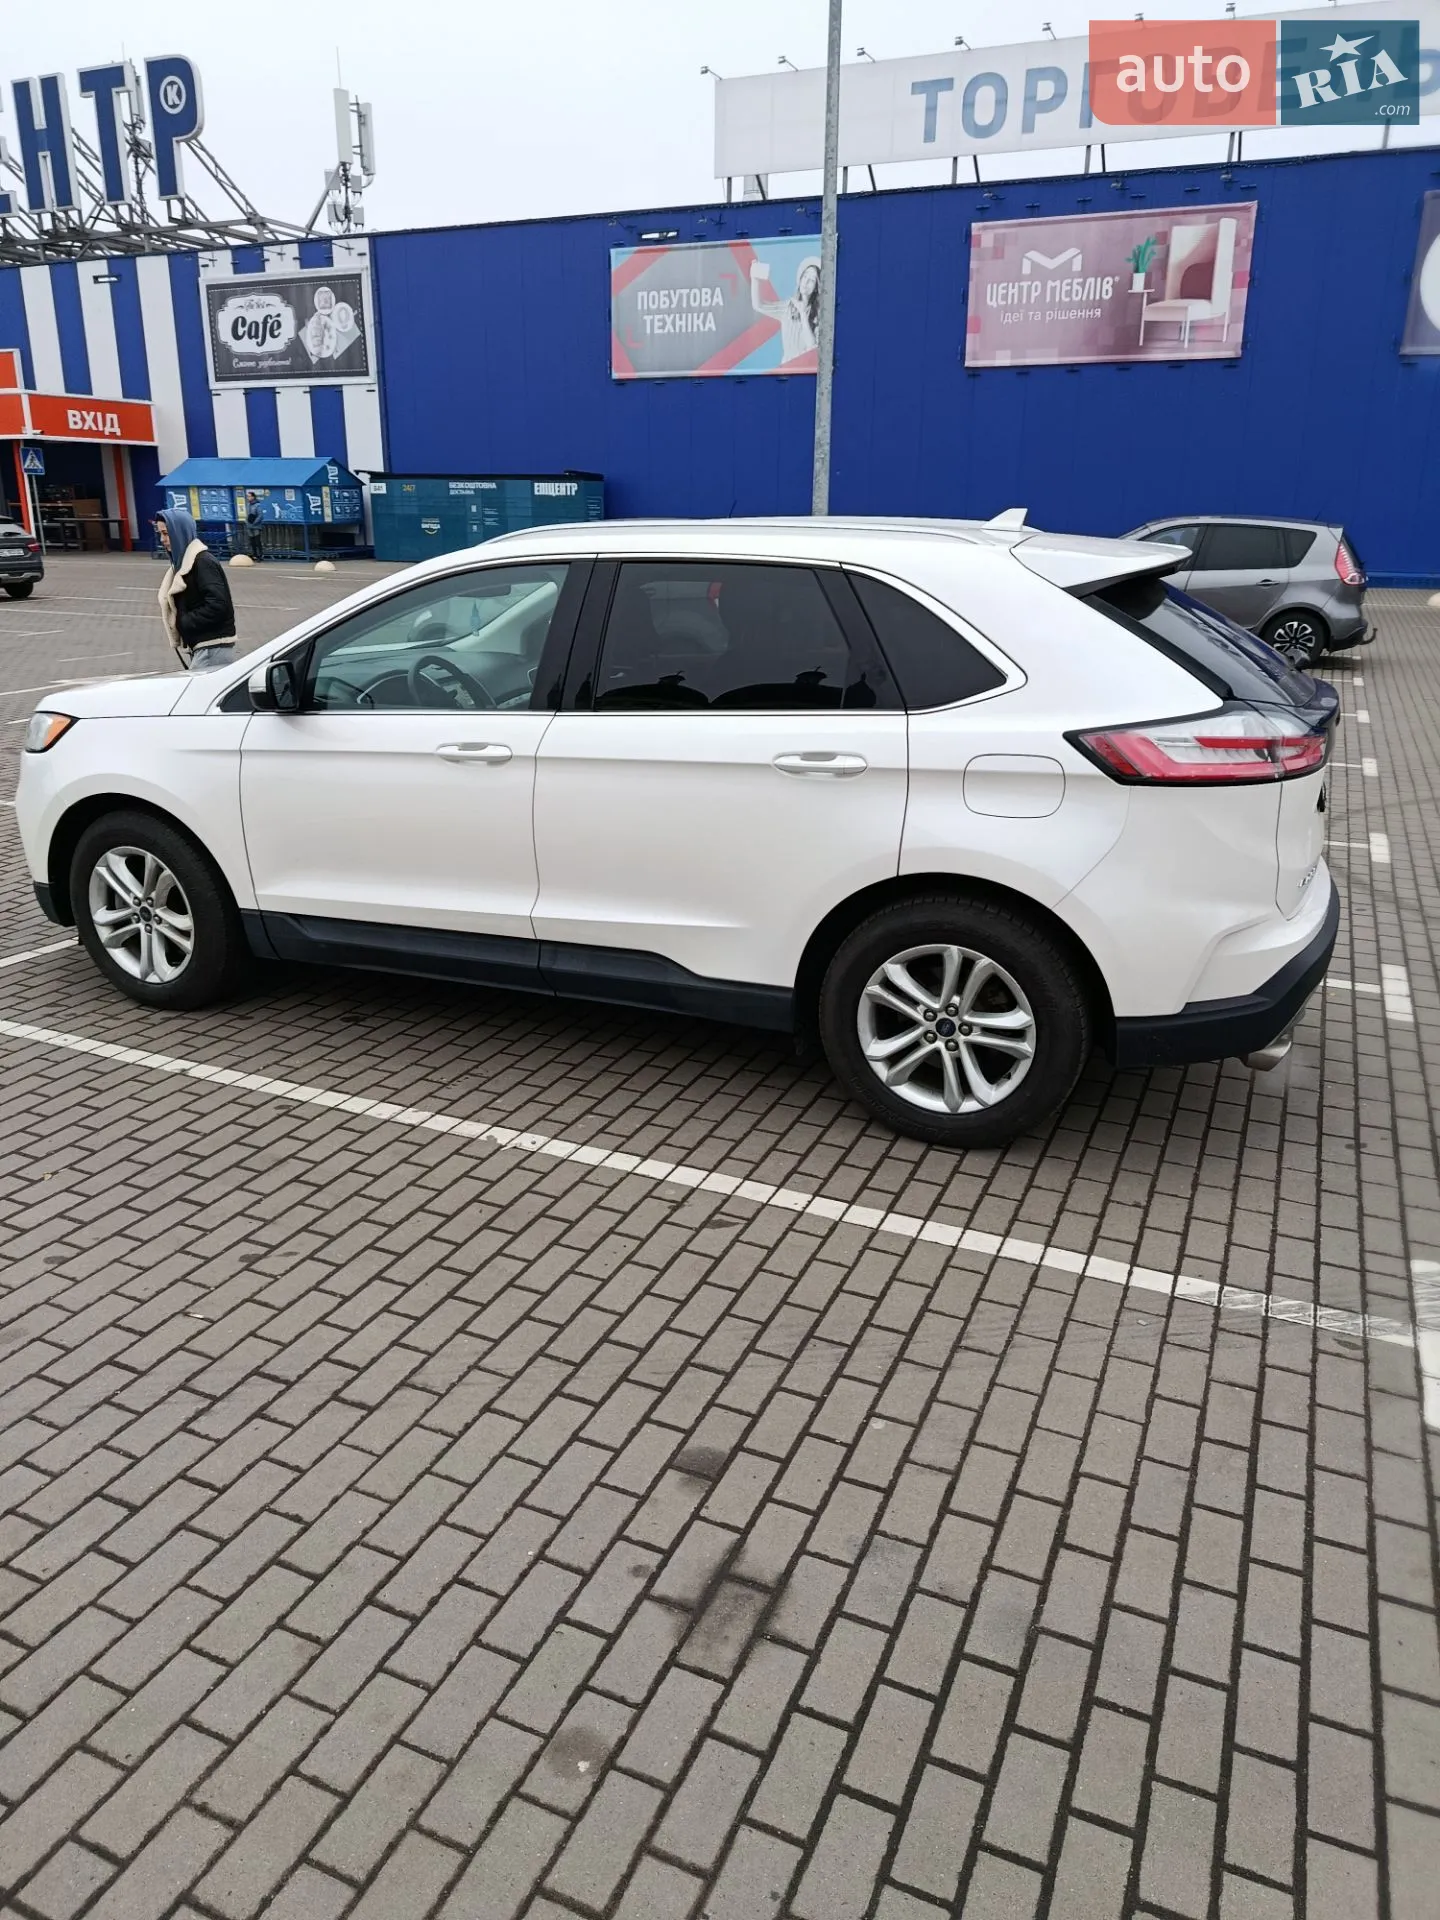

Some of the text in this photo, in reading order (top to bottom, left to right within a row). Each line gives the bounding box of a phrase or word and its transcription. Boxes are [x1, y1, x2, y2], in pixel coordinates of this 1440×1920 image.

[0, 54, 205, 217] НТР
[637, 287, 724, 311] ПОБУТОВА
[986, 280, 1042, 308] ЦЕНТР
[643, 312, 717, 334] ТЕХНІКА
[1000, 307, 1101, 325] ідеї та рішення
[231, 313, 282, 347] Café
[67, 409, 121, 436] ВХІД
